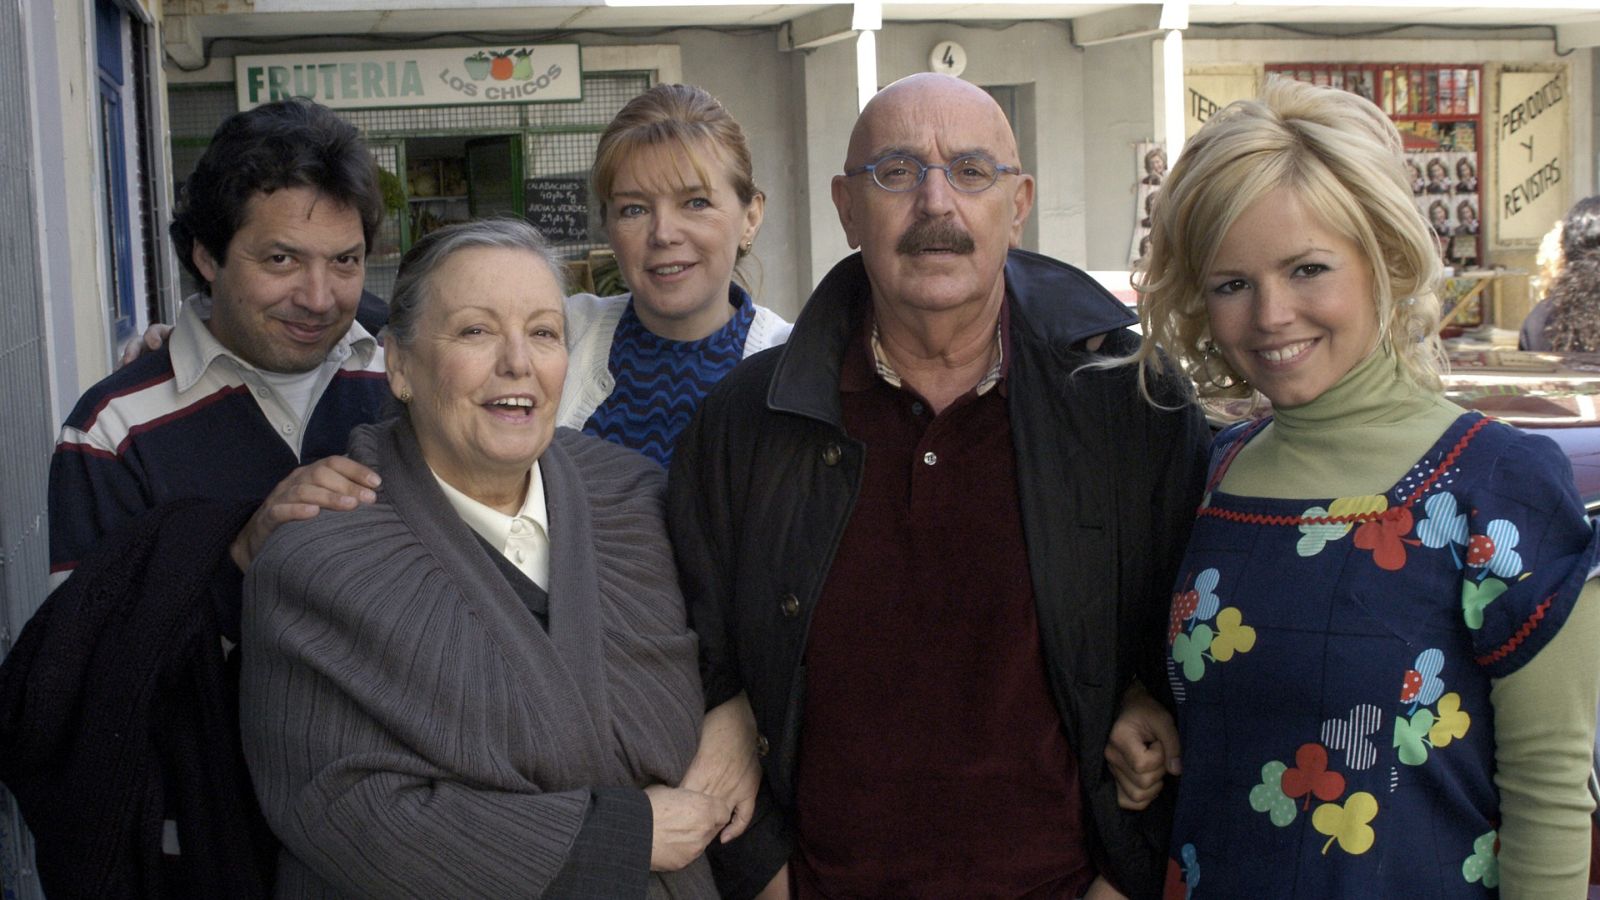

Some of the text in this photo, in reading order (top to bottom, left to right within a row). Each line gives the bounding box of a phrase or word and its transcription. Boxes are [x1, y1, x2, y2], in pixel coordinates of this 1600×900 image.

[942, 45, 955, 68] 4
[248, 60, 425, 103] FRUTERIA
[439, 63, 563, 100] LOS CHICOS
[1188, 87, 1222, 124] TE
[1502, 73, 1563, 141] PERIODICOS
[1520, 134, 1534, 163] Y
[1504, 157, 1562, 220] REVISTAS
